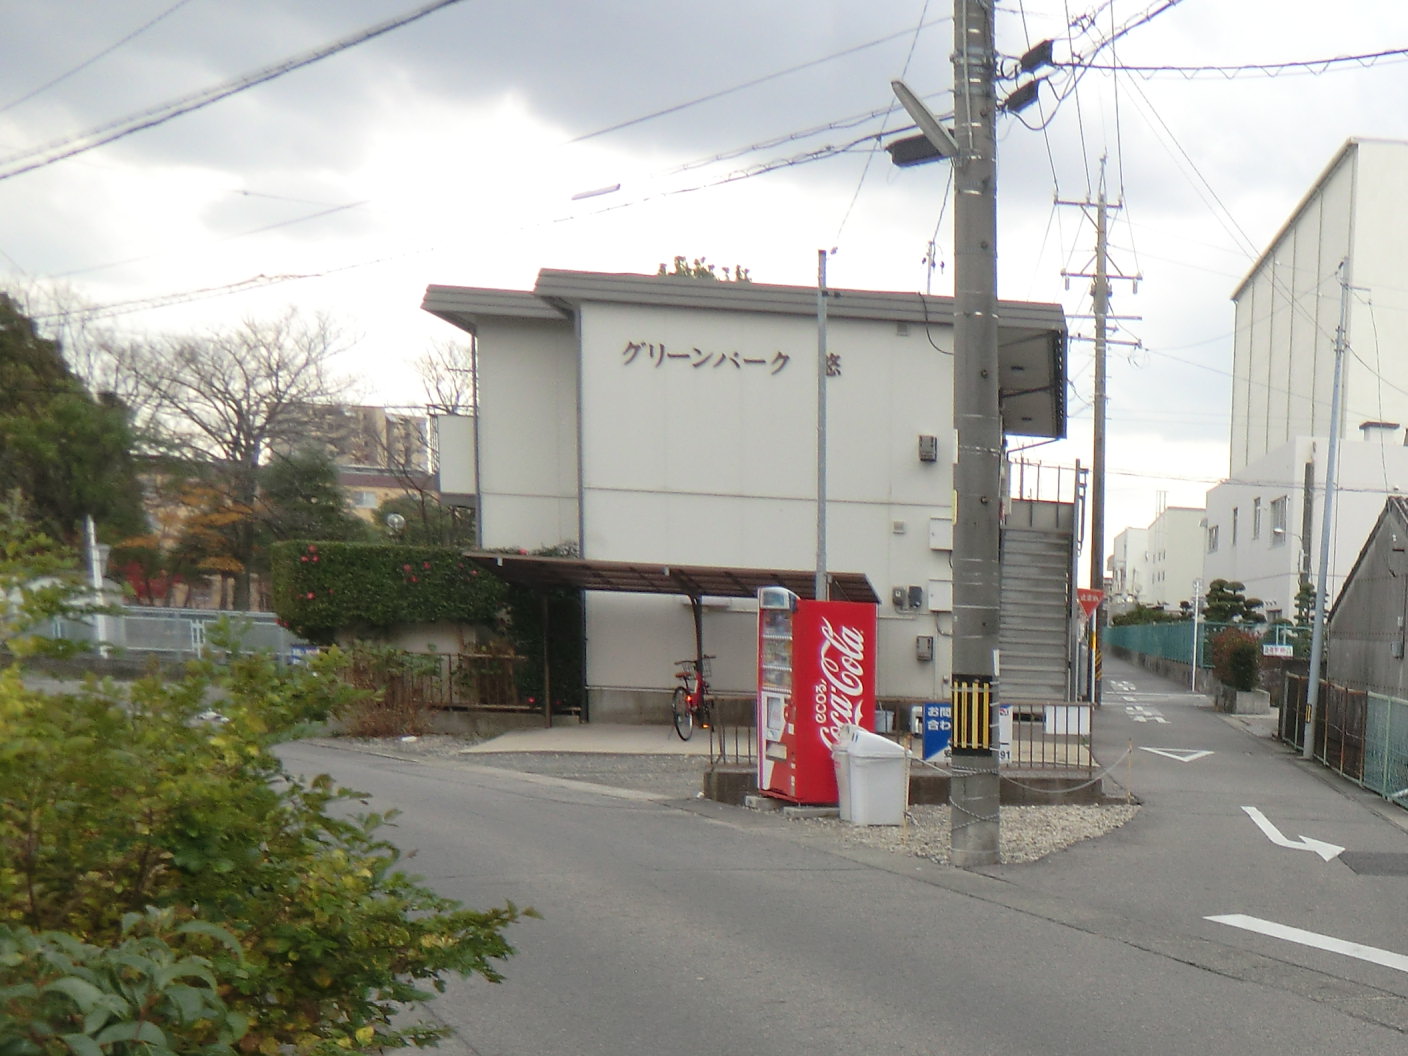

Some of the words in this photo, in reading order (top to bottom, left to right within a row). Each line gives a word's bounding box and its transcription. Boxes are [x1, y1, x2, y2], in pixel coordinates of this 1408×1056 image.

[622, 341, 790, 376] グリーンパーク
